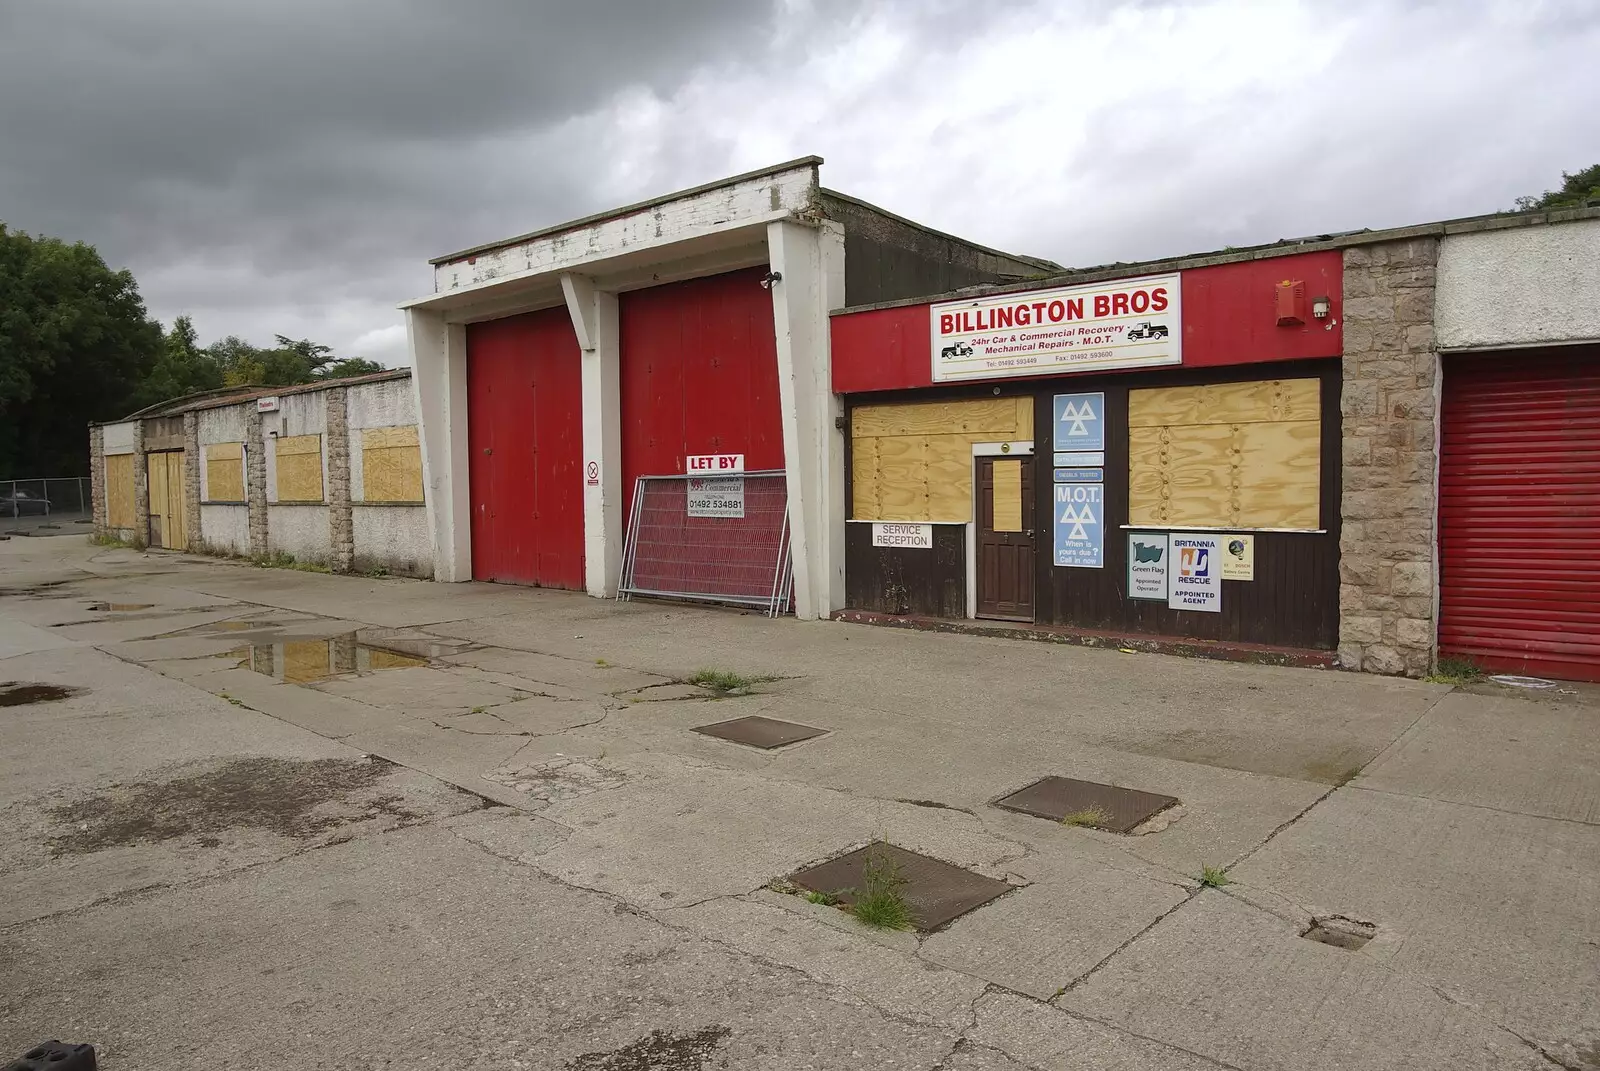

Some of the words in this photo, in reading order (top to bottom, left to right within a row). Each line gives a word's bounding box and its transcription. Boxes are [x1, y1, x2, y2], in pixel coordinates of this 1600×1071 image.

[940, 297, 1084, 335] BILLINGTON
[1094, 287, 1169, 318] BROS
[971, 338, 990, 346] 24hr
[992, 336, 1008, 344] Car
[1020, 328, 1075, 341] Commercial
[1078, 324, 1125, 336] Recovery
[985, 342, 1036, 354] Mechanical
[1038, 338, 1074, 351] Repairs
[1082, 335, 1114, 345] M.O.T.
[1070, 352, 1088, 360] 01492
[1090, 350, 1113, 359] 593600
[691, 457, 713, 469] LET
[719, 456, 738, 469] BY
[704, 483, 742, 492] Commercial
[1057, 487, 1100, 502] M.O.T.
[690, 500, 711, 508] 01492
[713, 500, 742, 509] 534881
[882, 524, 921, 535] SERVICE
[876, 535, 928, 546] RECEPTION
[1174, 540, 1216, 548] BRITANNIA
[1059, 548, 1077, 556] yours
[1079, 548, 1092, 556] due
[1092, 547, 1099, 556] ?
[1074, 556, 1080, 564] in
[1151, 566, 1165, 575] Flag
[1178, 576, 1211, 585] RESCUE
[1174, 590, 1215, 599] APPOINTED
